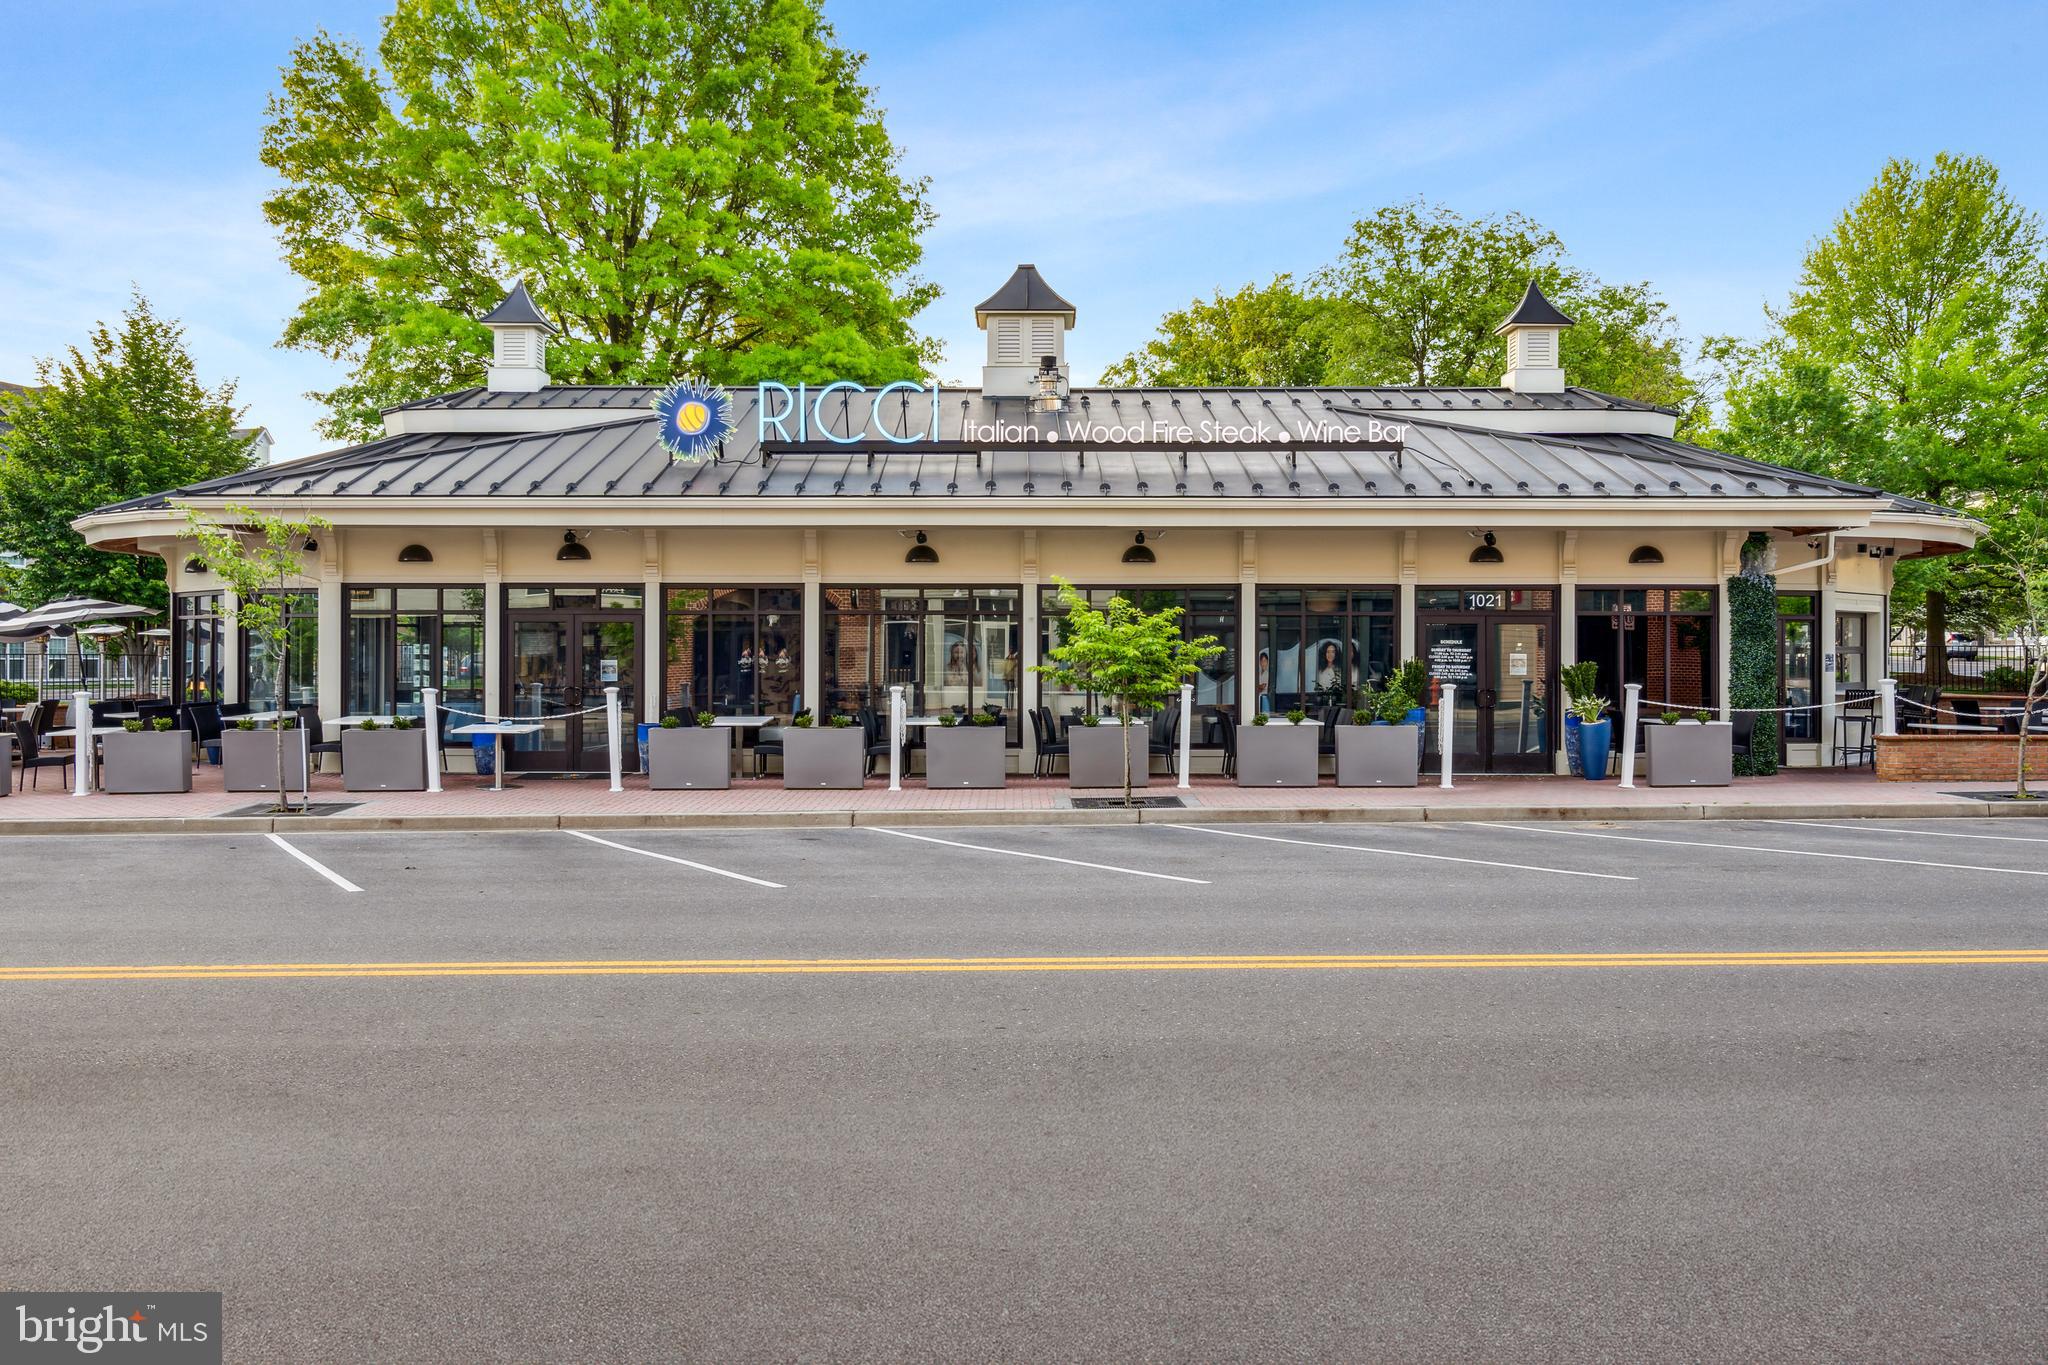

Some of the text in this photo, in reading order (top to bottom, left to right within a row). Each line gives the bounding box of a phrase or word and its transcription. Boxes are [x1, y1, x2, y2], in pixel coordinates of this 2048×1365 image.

[758, 381, 940, 444] RICCI
[963, 419, 1410, 443] Italian Wood Fire Steak Wine Bar
[1469, 593, 1502, 607] 1021
